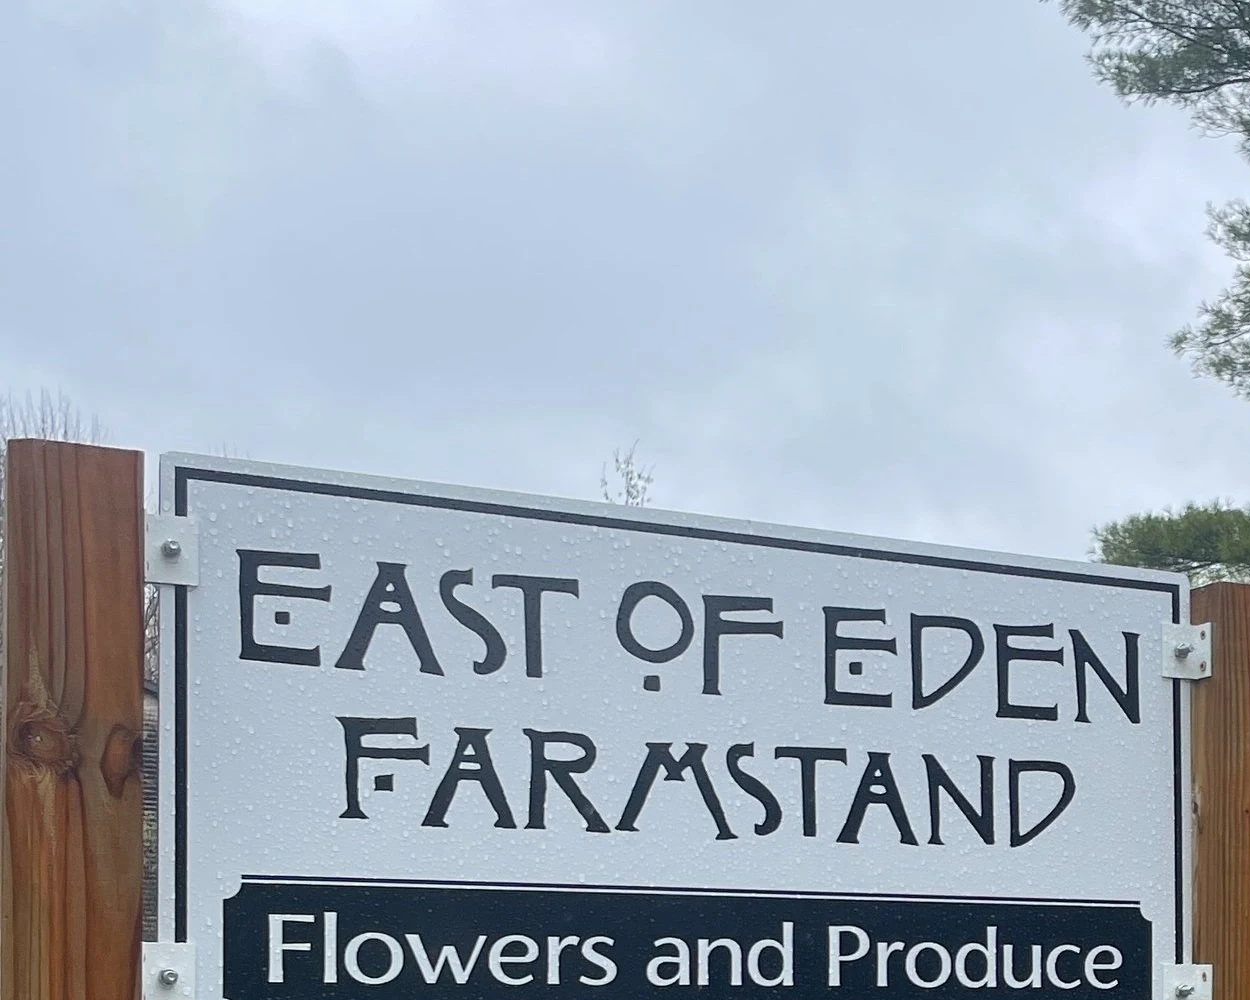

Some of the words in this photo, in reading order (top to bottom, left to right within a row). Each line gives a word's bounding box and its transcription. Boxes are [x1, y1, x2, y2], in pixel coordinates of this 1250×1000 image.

[235, 548, 580, 679] EAST
[615, 580, 784, 696] OF
[821, 605, 1141, 725] EDEN
[335, 716, 1076, 848] FARMSTAND
[267, 911, 618, 986] Flowers
[646, 921, 794, 987] and
[828, 925, 1123, 990] Produce
